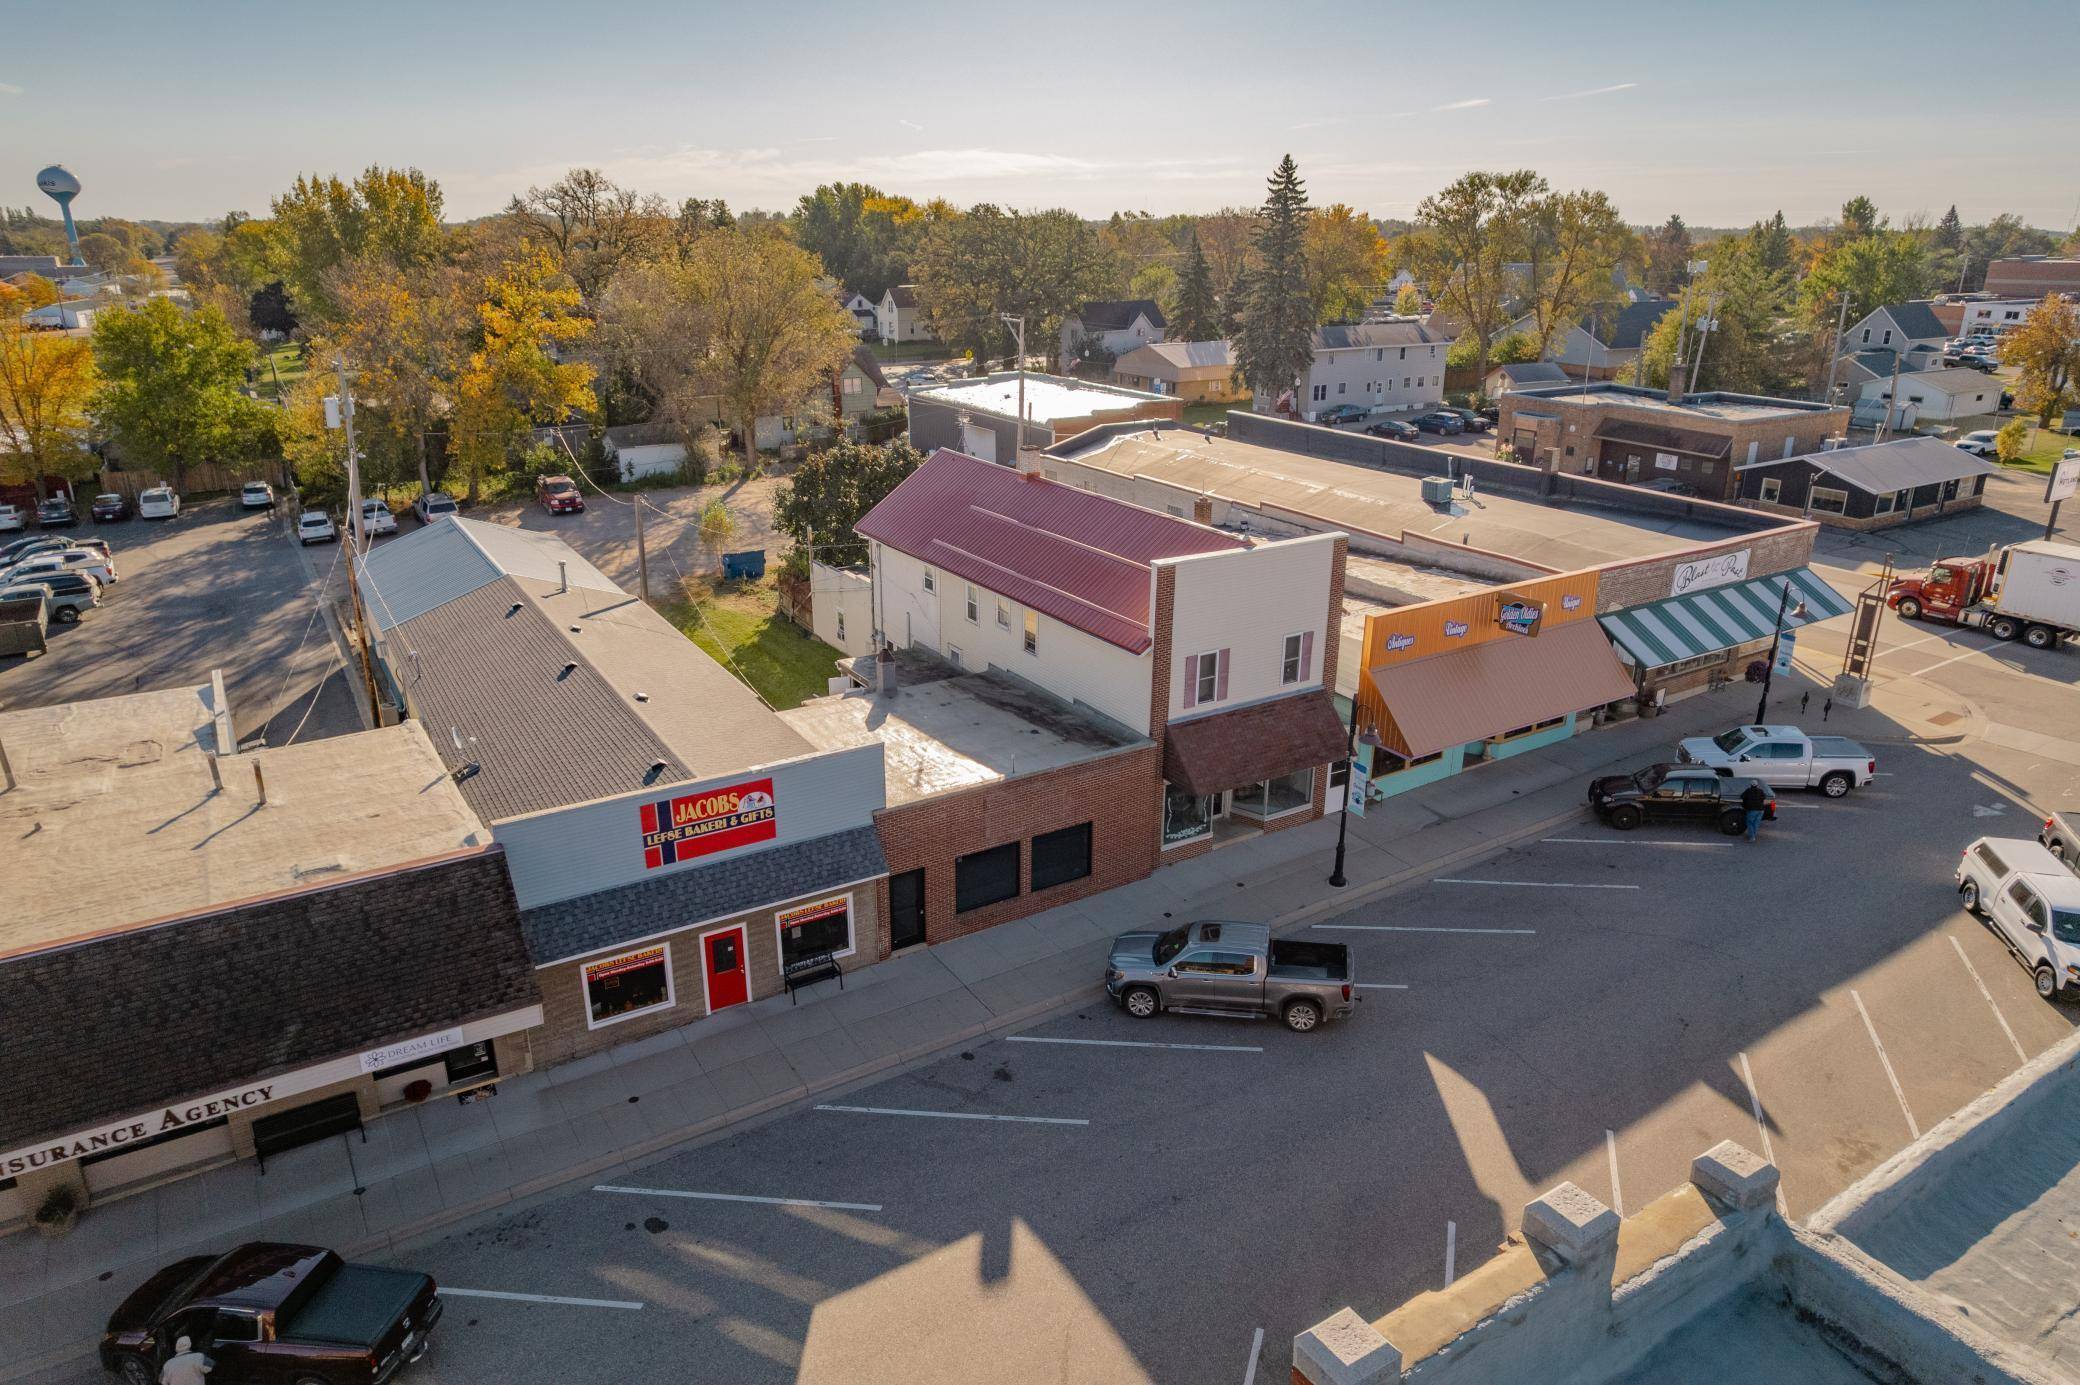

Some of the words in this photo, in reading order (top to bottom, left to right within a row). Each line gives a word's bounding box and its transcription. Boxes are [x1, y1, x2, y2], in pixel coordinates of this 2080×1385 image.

[1500, 608, 1520, 624] Golden
[1521, 606, 1539, 619] Oldies
[1445, 622, 1468, 637] Vintage
[1387, 634, 1414, 651] Antiques
[676, 792, 740, 823] JACOBS
[647, 828, 682, 846] LEFSE
[685, 818, 728, 837] BAKERI
[730, 816, 738, 826] &
[740, 807, 773, 823] GIFTS
[387, 1041, 427, 1058] DREAM
[428, 1034, 451, 1048] LIFE
